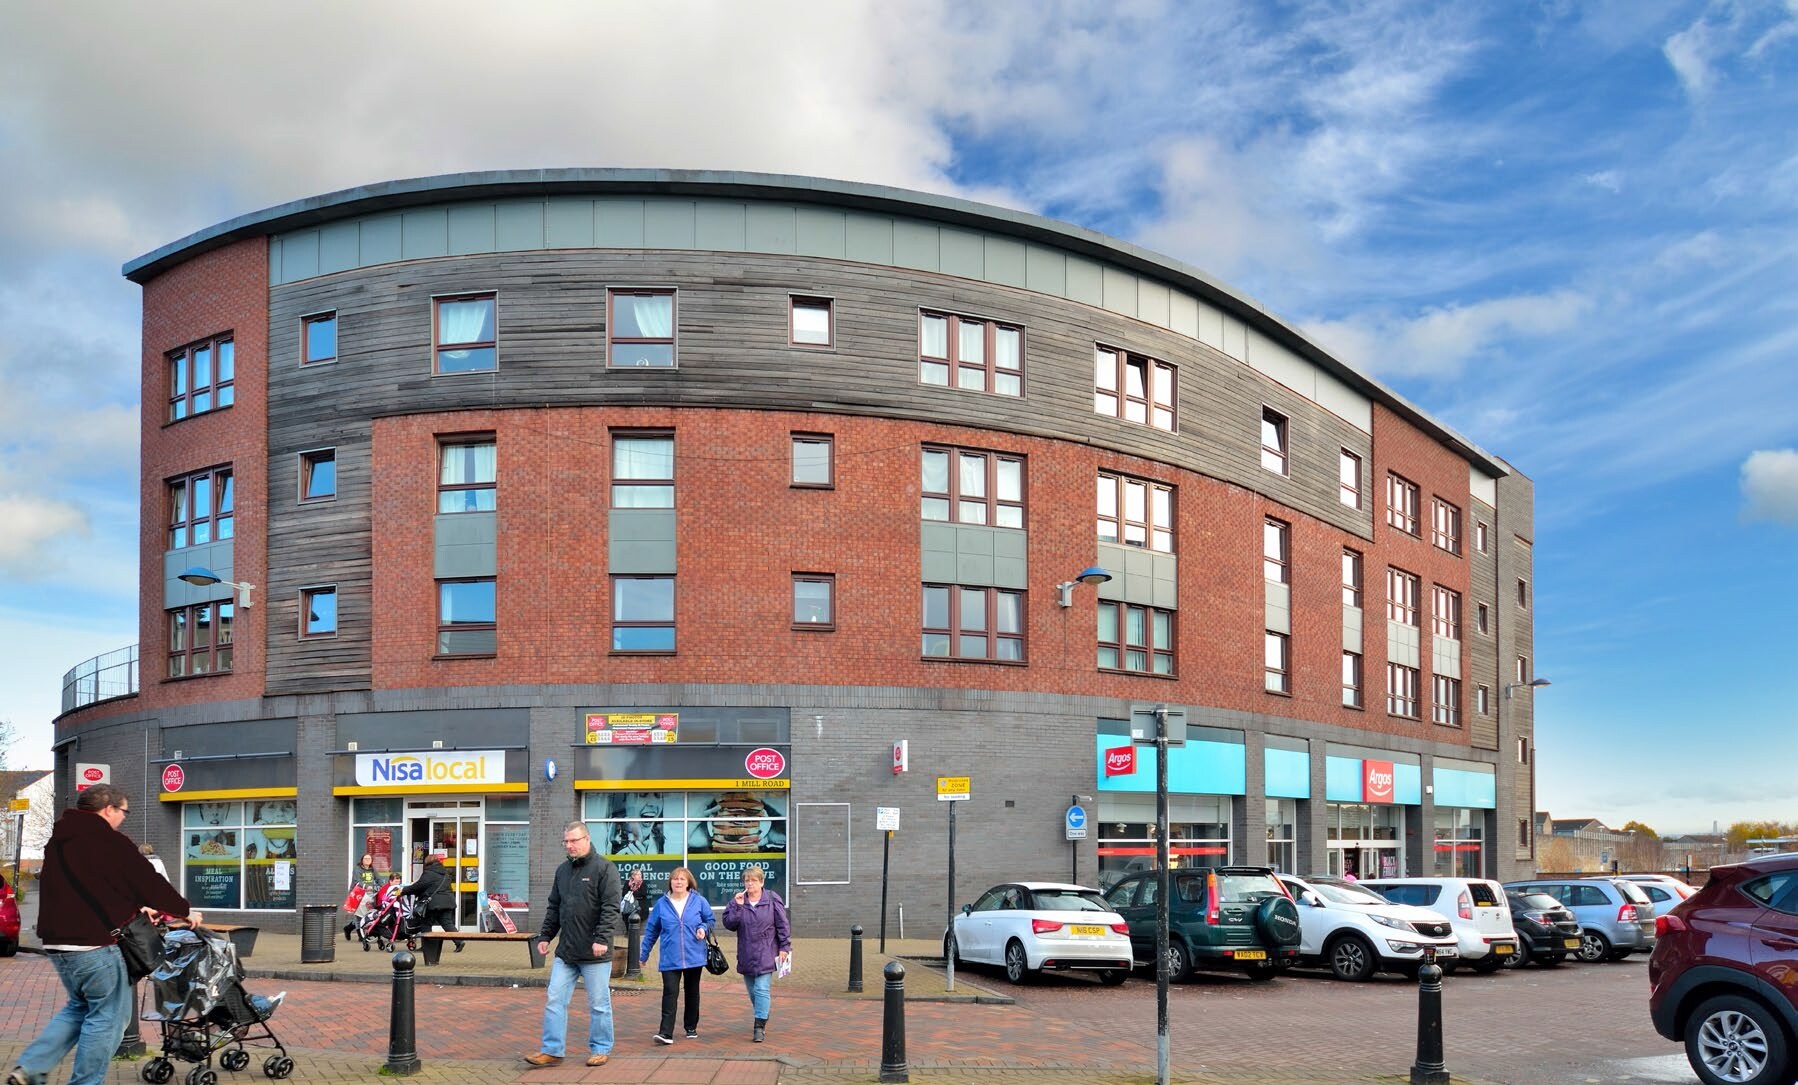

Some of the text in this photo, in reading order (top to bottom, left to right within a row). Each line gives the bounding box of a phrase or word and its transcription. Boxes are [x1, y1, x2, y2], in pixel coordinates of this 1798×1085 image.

[755, 755, 776, 763] POST
[1108, 753, 1132, 766] Argos
[372, 756, 485, 781] Nisa local
[167, 770, 179, 778] POST
[1368, 768, 1392, 788] Argos
[164, 777, 181, 785] OFFICE
[1383, 856, 1396, 867] BLACK
[618, 863, 653, 872] LOCAL
[704, 862, 770, 871] GOOD FOOD
[205, 867, 223, 875] MEAL
[265, 867, 295, 875] ALS
[195, 875, 234, 883] INSPIRATION
[700, 872, 715, 880] ON
[718, 872, 740, 880] THE
[1274, 914, 1297, 926] HONDA
